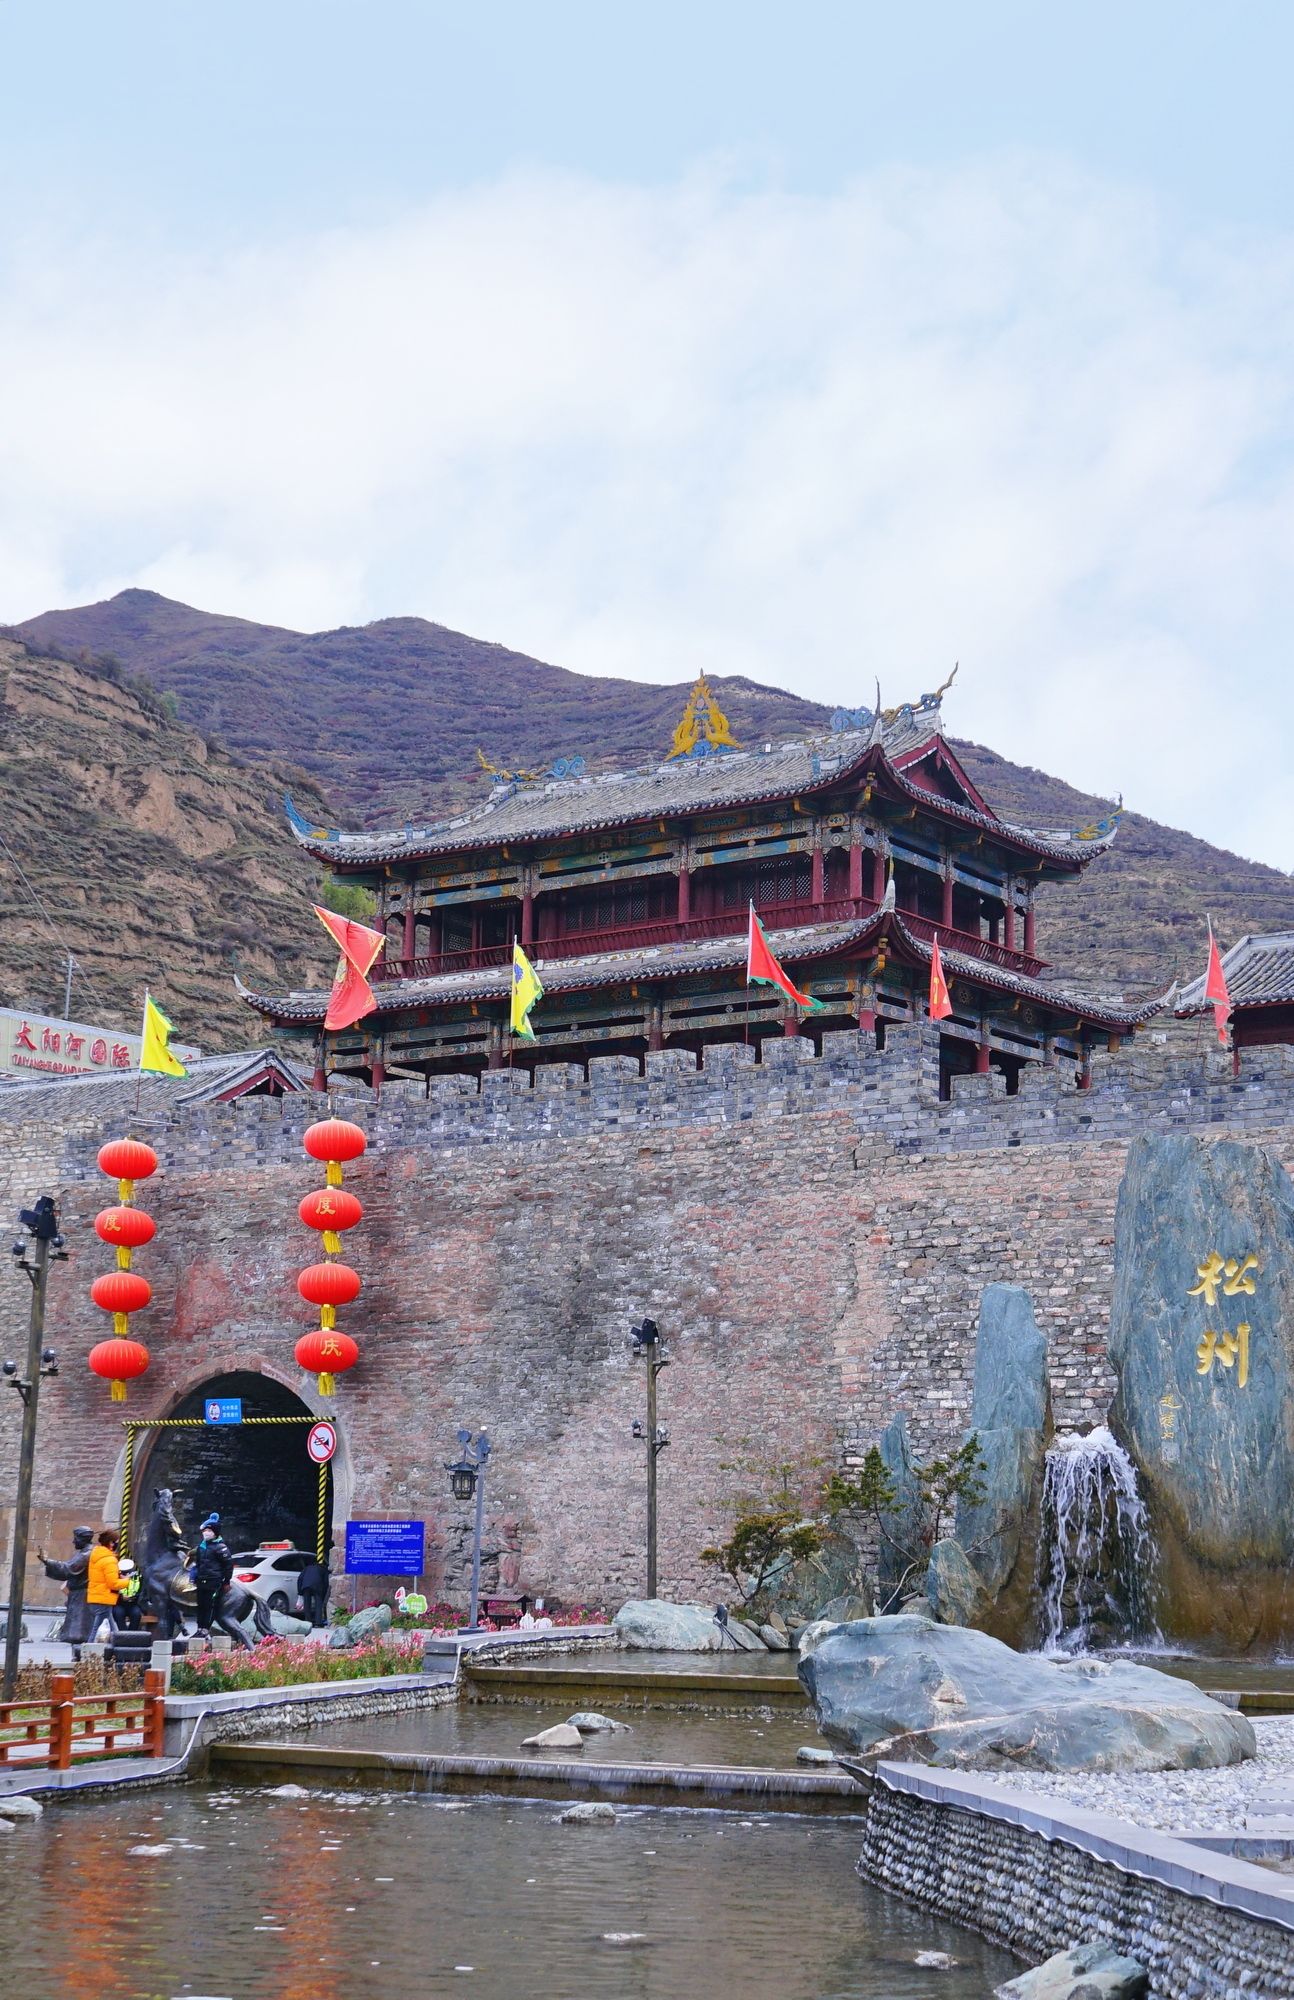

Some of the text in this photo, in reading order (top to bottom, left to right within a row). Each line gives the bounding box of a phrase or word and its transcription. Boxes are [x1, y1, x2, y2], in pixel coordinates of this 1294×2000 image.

[315, 1197, 336, 1215] 度
[103, 1214, 122, 1232] 度
[1186, 1250, 1258, 1388] 松州
[321, 1338, 342, 1356] 庆
